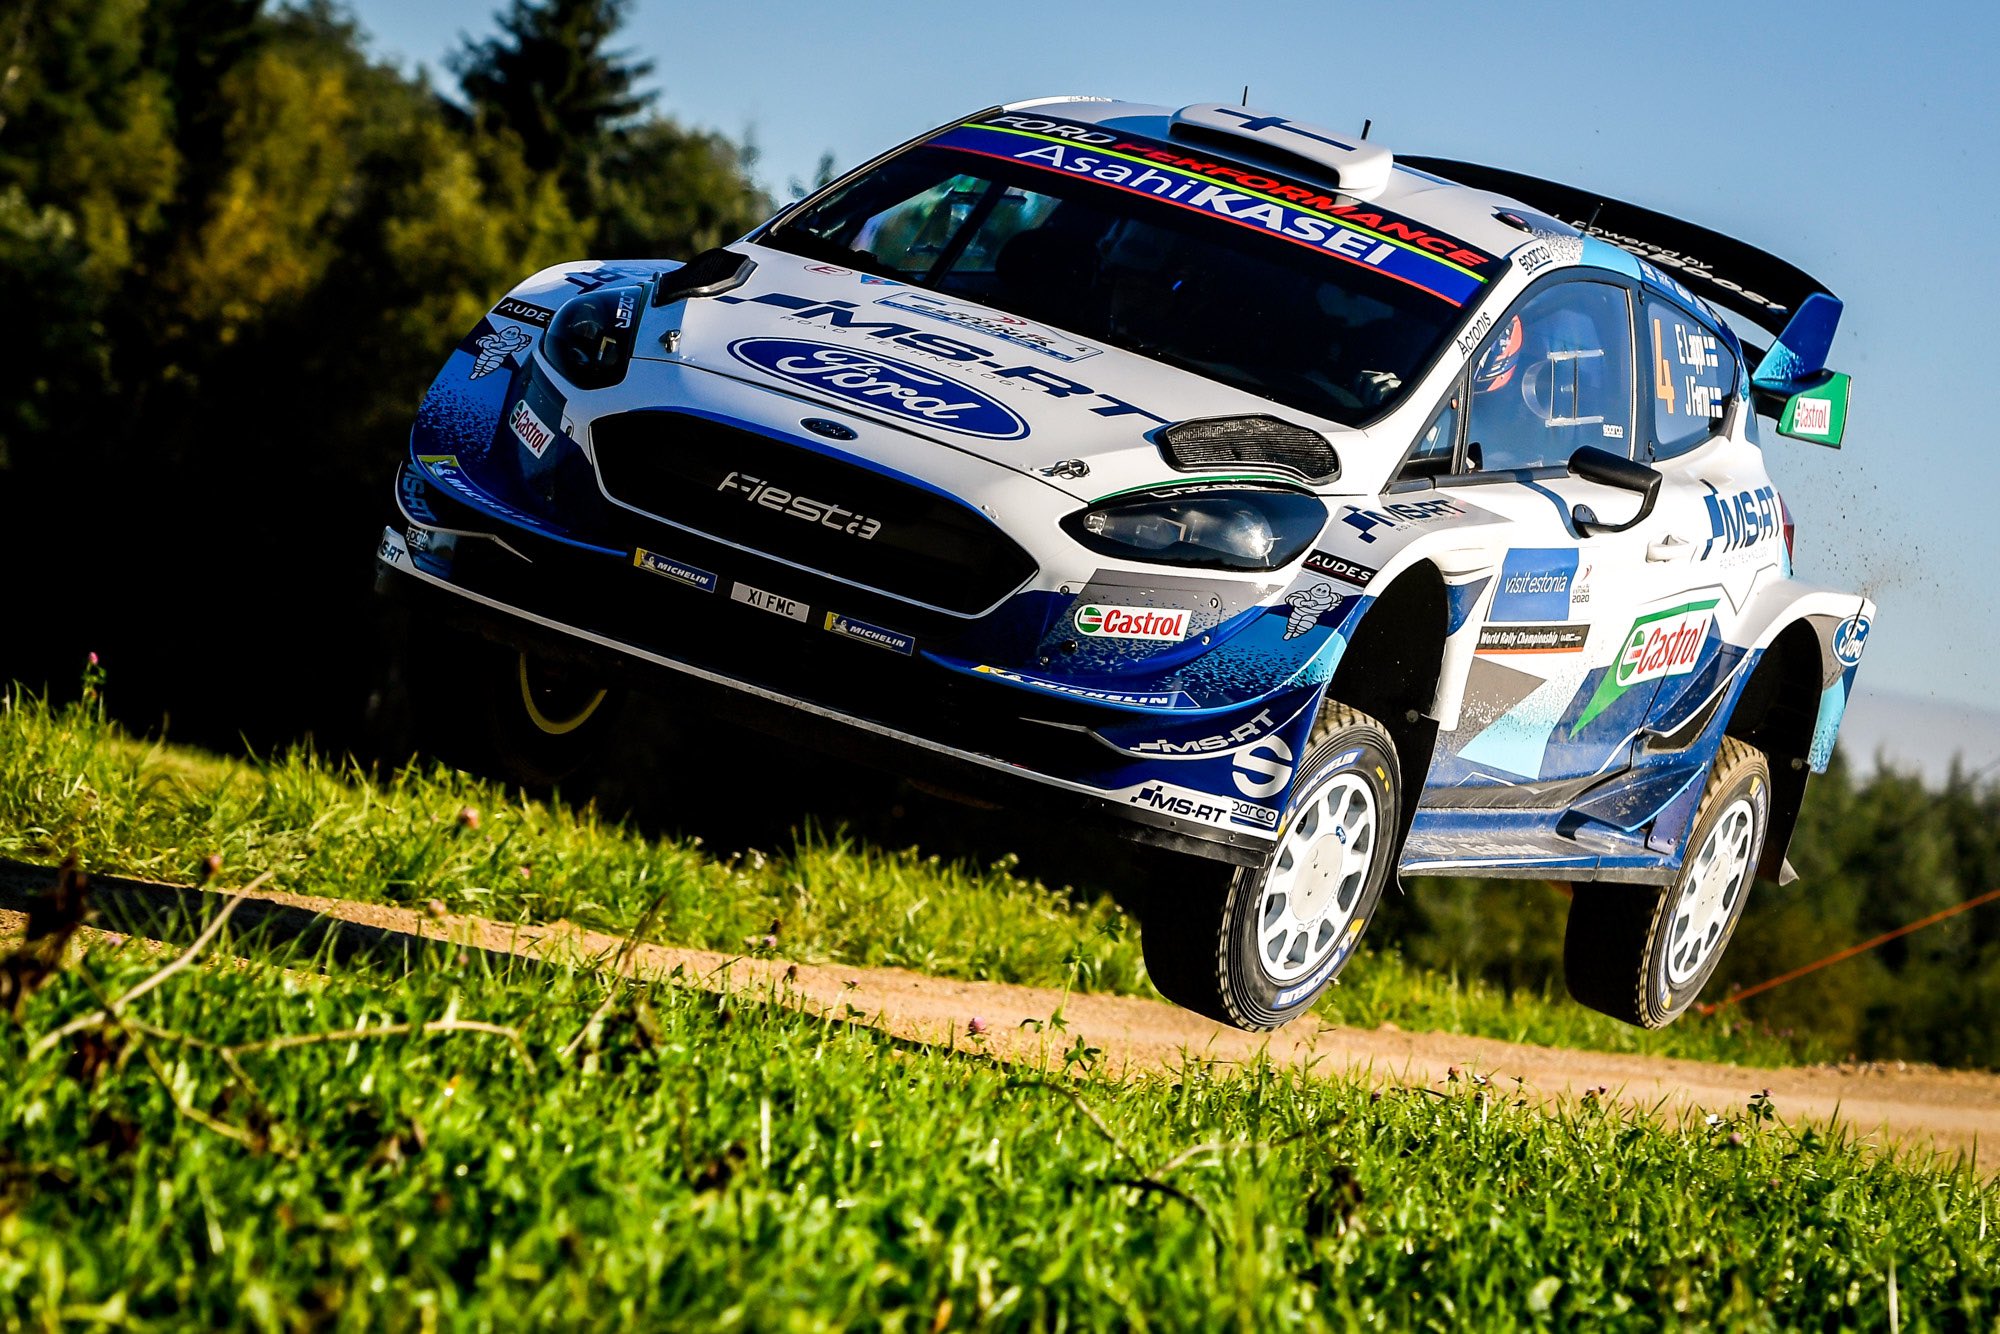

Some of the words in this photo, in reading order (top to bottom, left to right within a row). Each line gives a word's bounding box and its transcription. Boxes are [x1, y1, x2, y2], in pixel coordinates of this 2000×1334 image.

[984, 115, 1118, 143] FORD
[1112, 142, 1489, 267] PERFORMANCE
[1518, 246, 1550, 274] sparco
[1682, 254, 1714, 270] by
[500, 302, 553, 325] AUDE
[1456, 311, 1492, 360] Acronis
[780, 315, 848, 334] ROAD
[863, 336, 1033, 392] TECHNOLOGY
[791, 305, 1170, 427] MS-RT
[1653, 318, 1675, 414] 4
[775, 350, 982, 419] Ford
[1800, 402, 1827, 429] Castrol
[515, 409, 550, 453] Castrol
[444, 476, 541, 525] MICHELIN
[717, 471, 881, 540] Fiesta
[1361, 499, 1467, 528] MS-RT
[1719, 485, 1780, 554] MS-RT
[656, 560, 709, 587] MICHELIN
[1306, 554, 1372, 581] AUDES
[1504, 571, 1530, 594] visit
[1528, 571, 1568, 594] estonia
[766, 595, 796, 617] FMC
[1571, 594, 1590, 603] 2020
[848, 624, 907, 649] MICHELIN
[1102, 609, 1183, 637] Castrol
[1480, 631, 1501, 645] World
[1499, 631, 1518, 647] Rally
[1515, 631, 1559, 647] Championship
[1637, 618, 1707, 675] Castrol
[1838, 620, 1868, 659] Ford
[1028, 680, 1169, 705] MICHELIN
[1162, 708, 1275, 753] MS-RT
[1149, 791, 1227, 823] MS-RT
